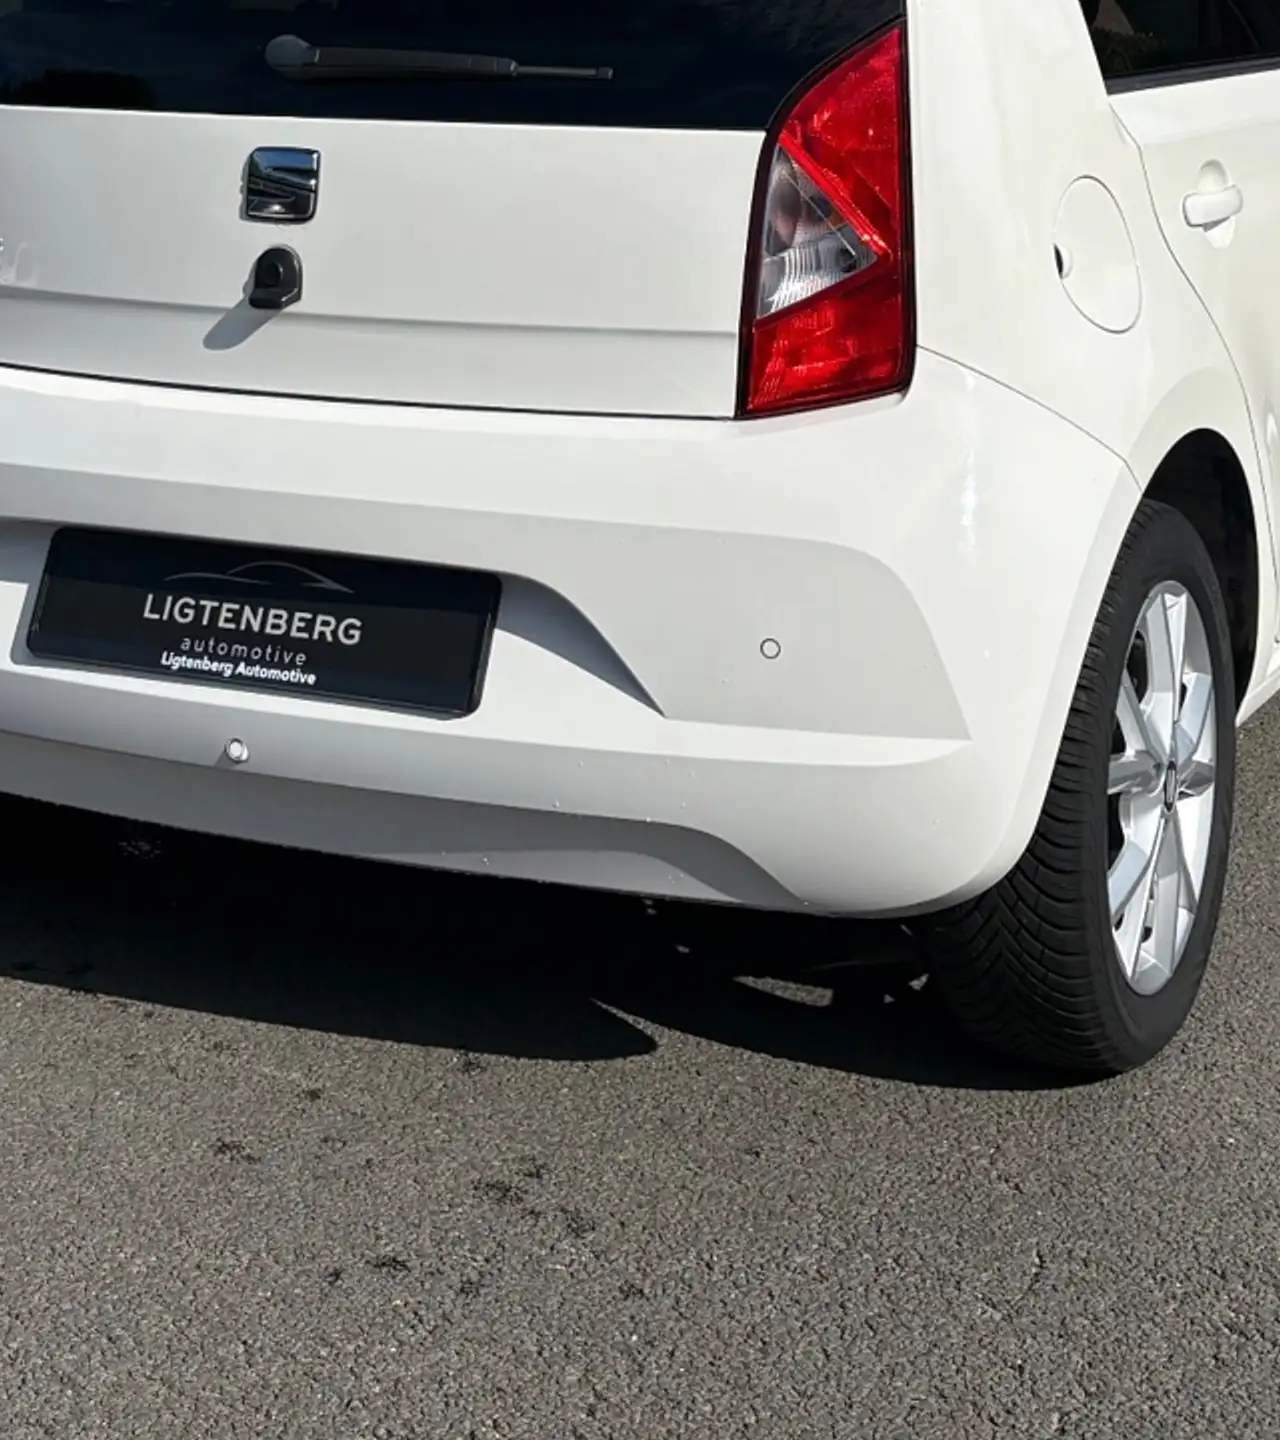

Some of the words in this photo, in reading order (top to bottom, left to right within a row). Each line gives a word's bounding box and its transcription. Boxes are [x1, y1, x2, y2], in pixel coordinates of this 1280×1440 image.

[143, 593, 363, 646] LIGTENBERG
[161, 650, 234, 678] Ligtenberg
[235, 661, 317, 686] Automotive
[180, 636, 307, 666] automotive
